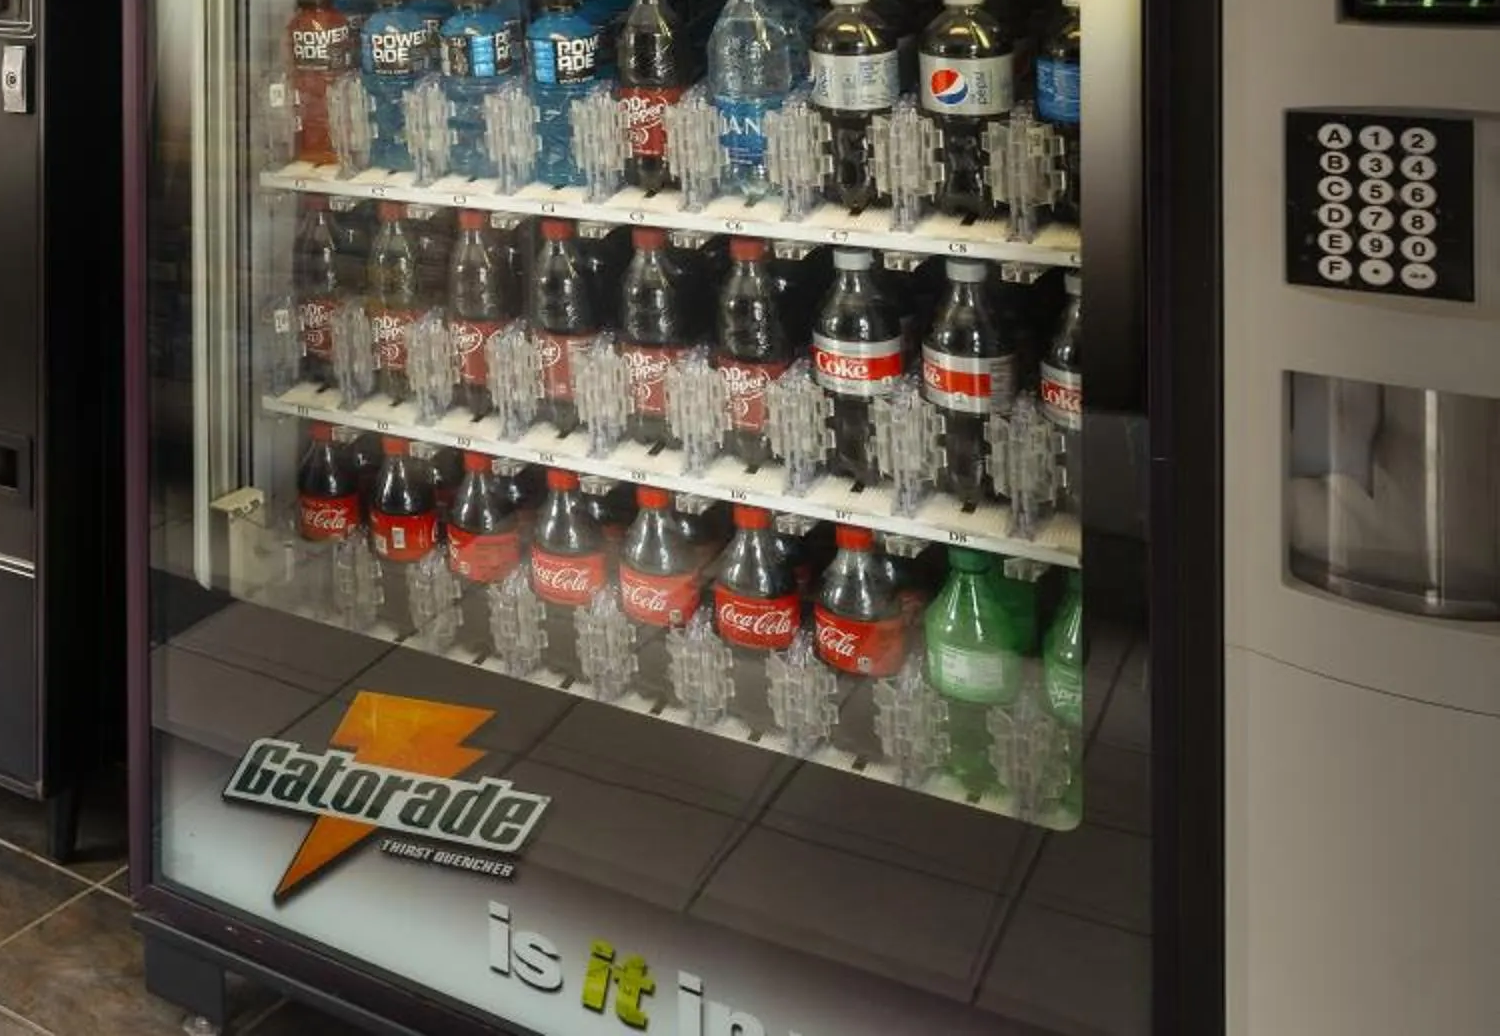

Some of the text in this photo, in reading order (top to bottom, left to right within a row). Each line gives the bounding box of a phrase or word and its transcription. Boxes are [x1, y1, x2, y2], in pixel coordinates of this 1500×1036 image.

[1327, 129, 1425, 149] A 1 2
[1328, 155, 1425, 176] B 3 4
[1327, 181, 1425, 203] C 5 6
[1327, 208, 1425, 230] D 7 8
[1328, 234, 1426, 257] E 9 0
[1329, 261, 1343, 275] F
[815, 352, 869, 380] Coke
[720, 602, 793, 636] Coca-Cola
[233, 742, 542, 848] Gatorade
[382, 839, 514, 877] THIRST QUENCHER
[488, 899, 564, 993] is
[581, 938, 657, 1031] it
